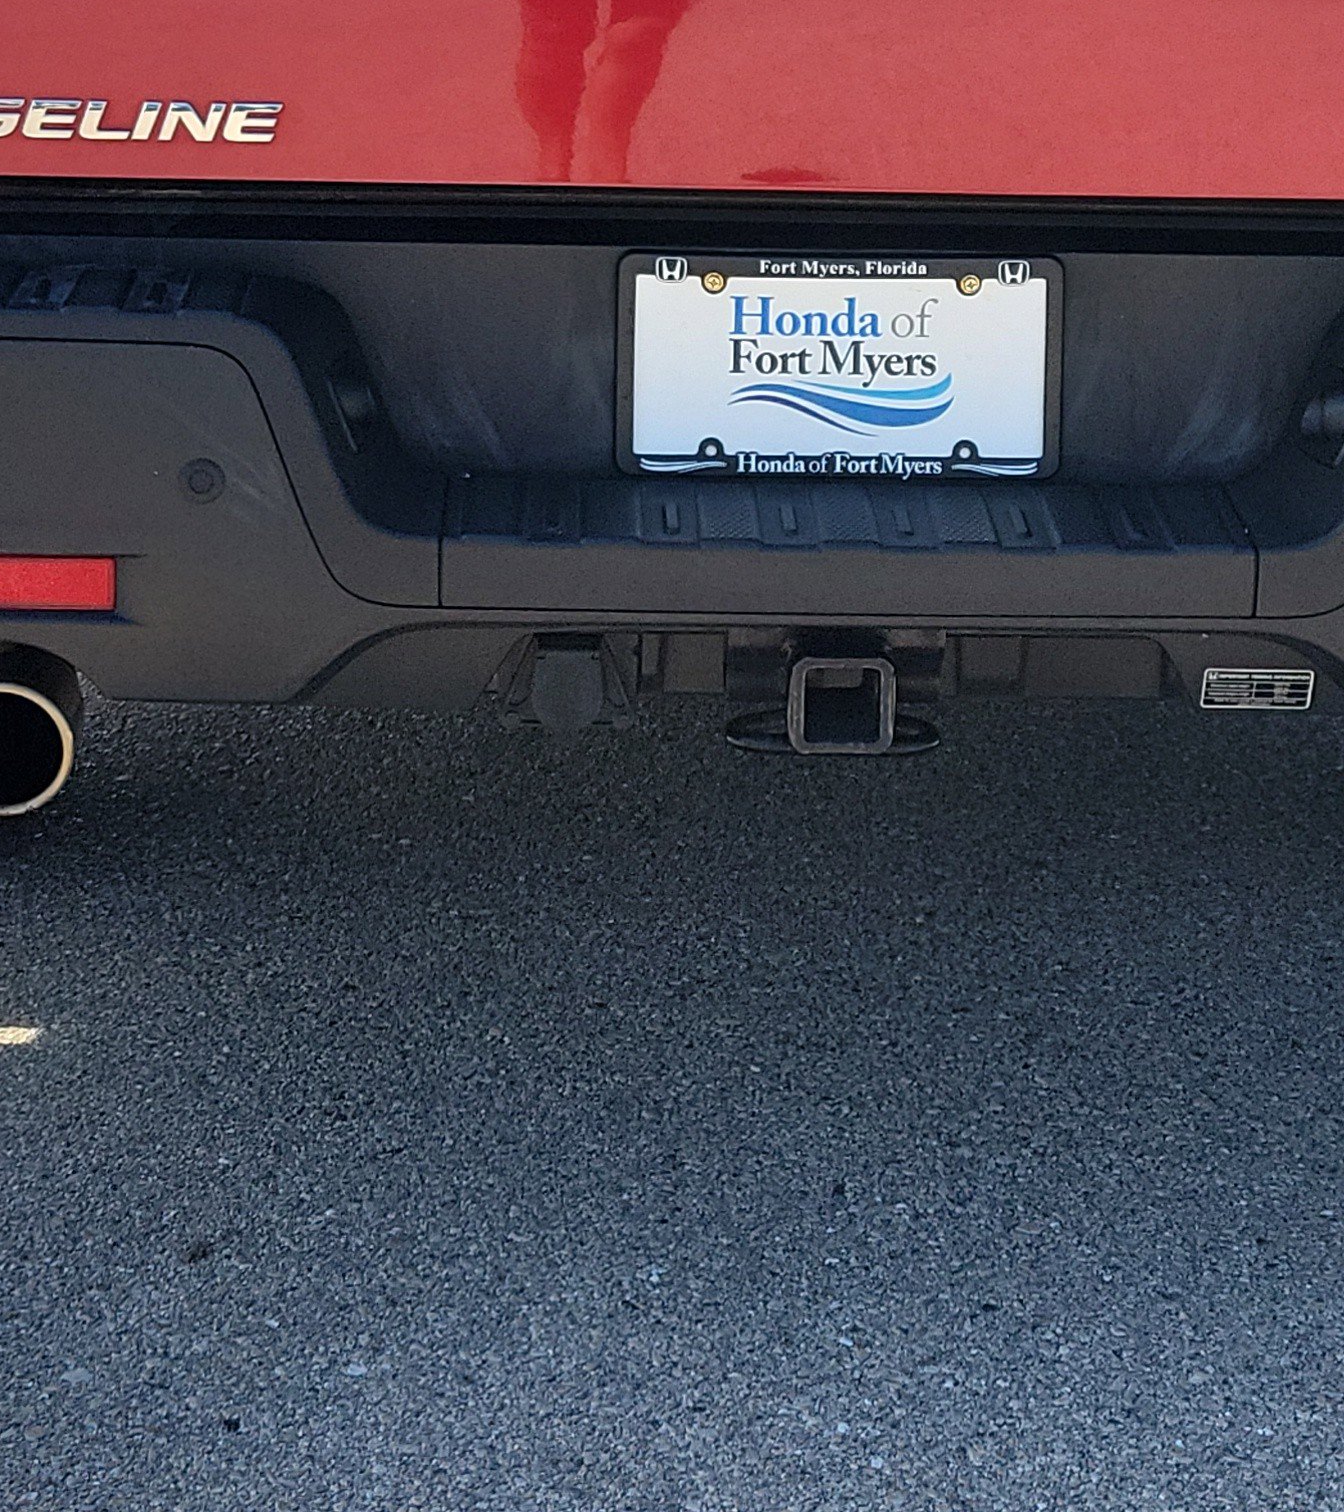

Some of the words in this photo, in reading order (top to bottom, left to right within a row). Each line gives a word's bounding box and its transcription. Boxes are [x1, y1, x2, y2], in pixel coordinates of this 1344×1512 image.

[759, 260, 797, 275] Fort
[801, 261, 861, 277] Myers,
[865, 261, 927, 276] Florida
[729, 296, 880, 338] Honda
[890, 298, 939, 338] of
[729, 339, 813, 375] Fort
[819, 340, 937, 388] Myers
[736, 454, 806, 473] Honda
[808, 453, 830, 474] of
[834, 454, 879, 474] Fort
[881, 454, 943, 480] Myers
